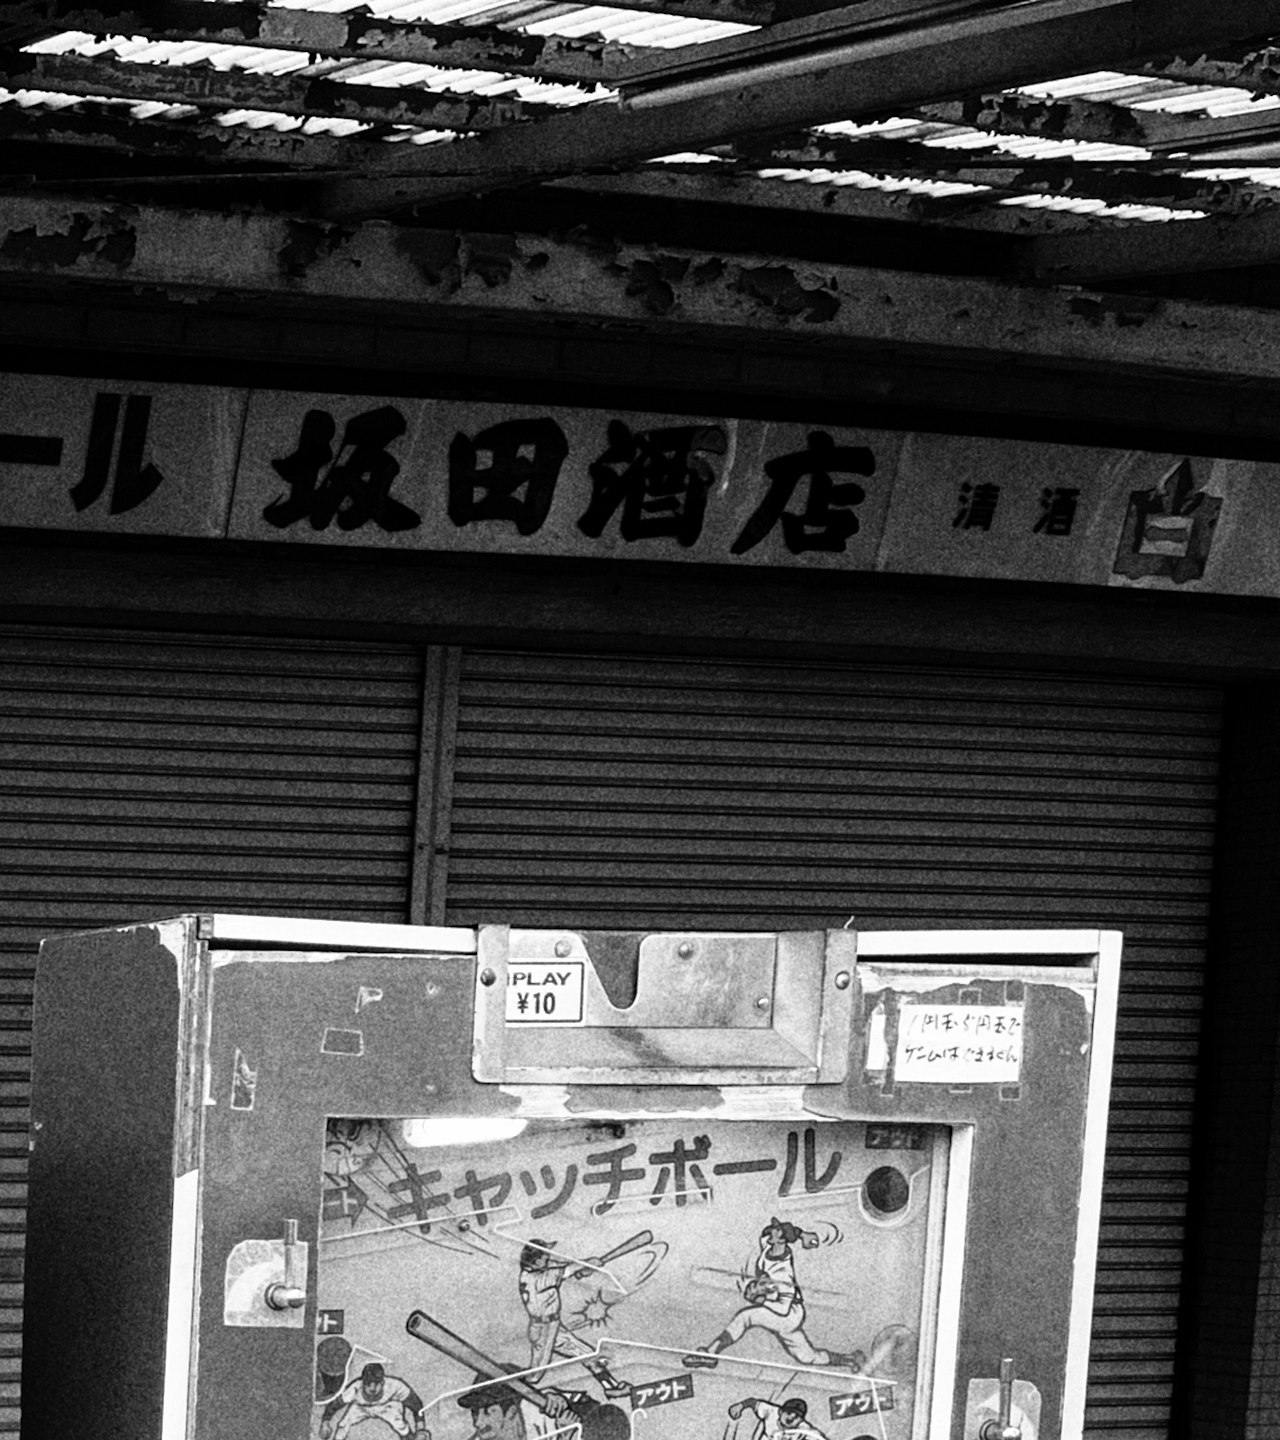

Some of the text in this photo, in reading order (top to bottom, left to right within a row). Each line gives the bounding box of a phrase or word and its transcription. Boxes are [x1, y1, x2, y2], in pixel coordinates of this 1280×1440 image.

[263, 406, 875, 554] 坂田酒店
[953, 482, 1080, 536] 清酒
[516, 991, 556, 1015] ¥10
[387, 1128, 844, 1235] キャッチボール
[635, 1380, 688, 1405] アウト
[834, 1391, 887, 1416] アウト
